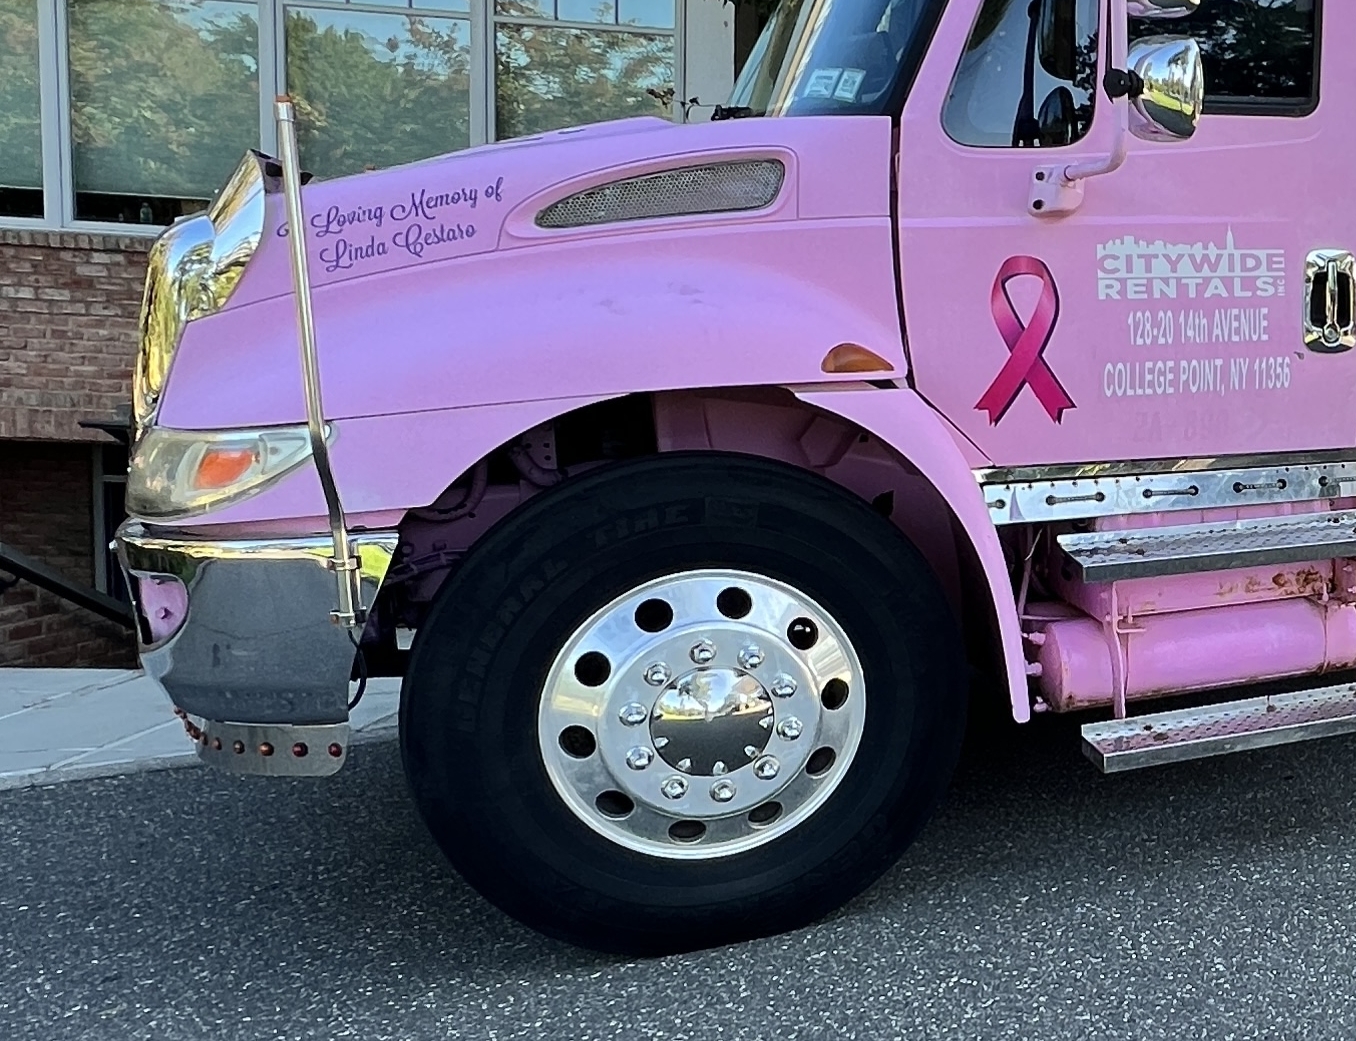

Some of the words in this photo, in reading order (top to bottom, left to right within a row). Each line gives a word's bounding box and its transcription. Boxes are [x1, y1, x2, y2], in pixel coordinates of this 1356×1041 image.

[311, 206, 384, 237] Loving
[391, 188, 478, 221] Memory
[485, 176, 504, 202] of
[320, 235, 387, 273] Linda
[393, 223, 477, 257] Cestaro
[1098, 251, 1285, 276] CITYWIDE
[1097, 276, 1276, 300] RENTALS
[1277, 279, 1286, 296] INC
[1127, 309, 1174, 345] 128-20
[1178, 309, 1209, 344] 14th
[1212, 307, 1269, 343] AVENUE
[1104, 359, 1175, 398] COLLEGE
[1179, 358, 1225, 397] POINT,
[1229, 357, 1250, 391] NY
[1254, 356, 1291, 390] 11356
